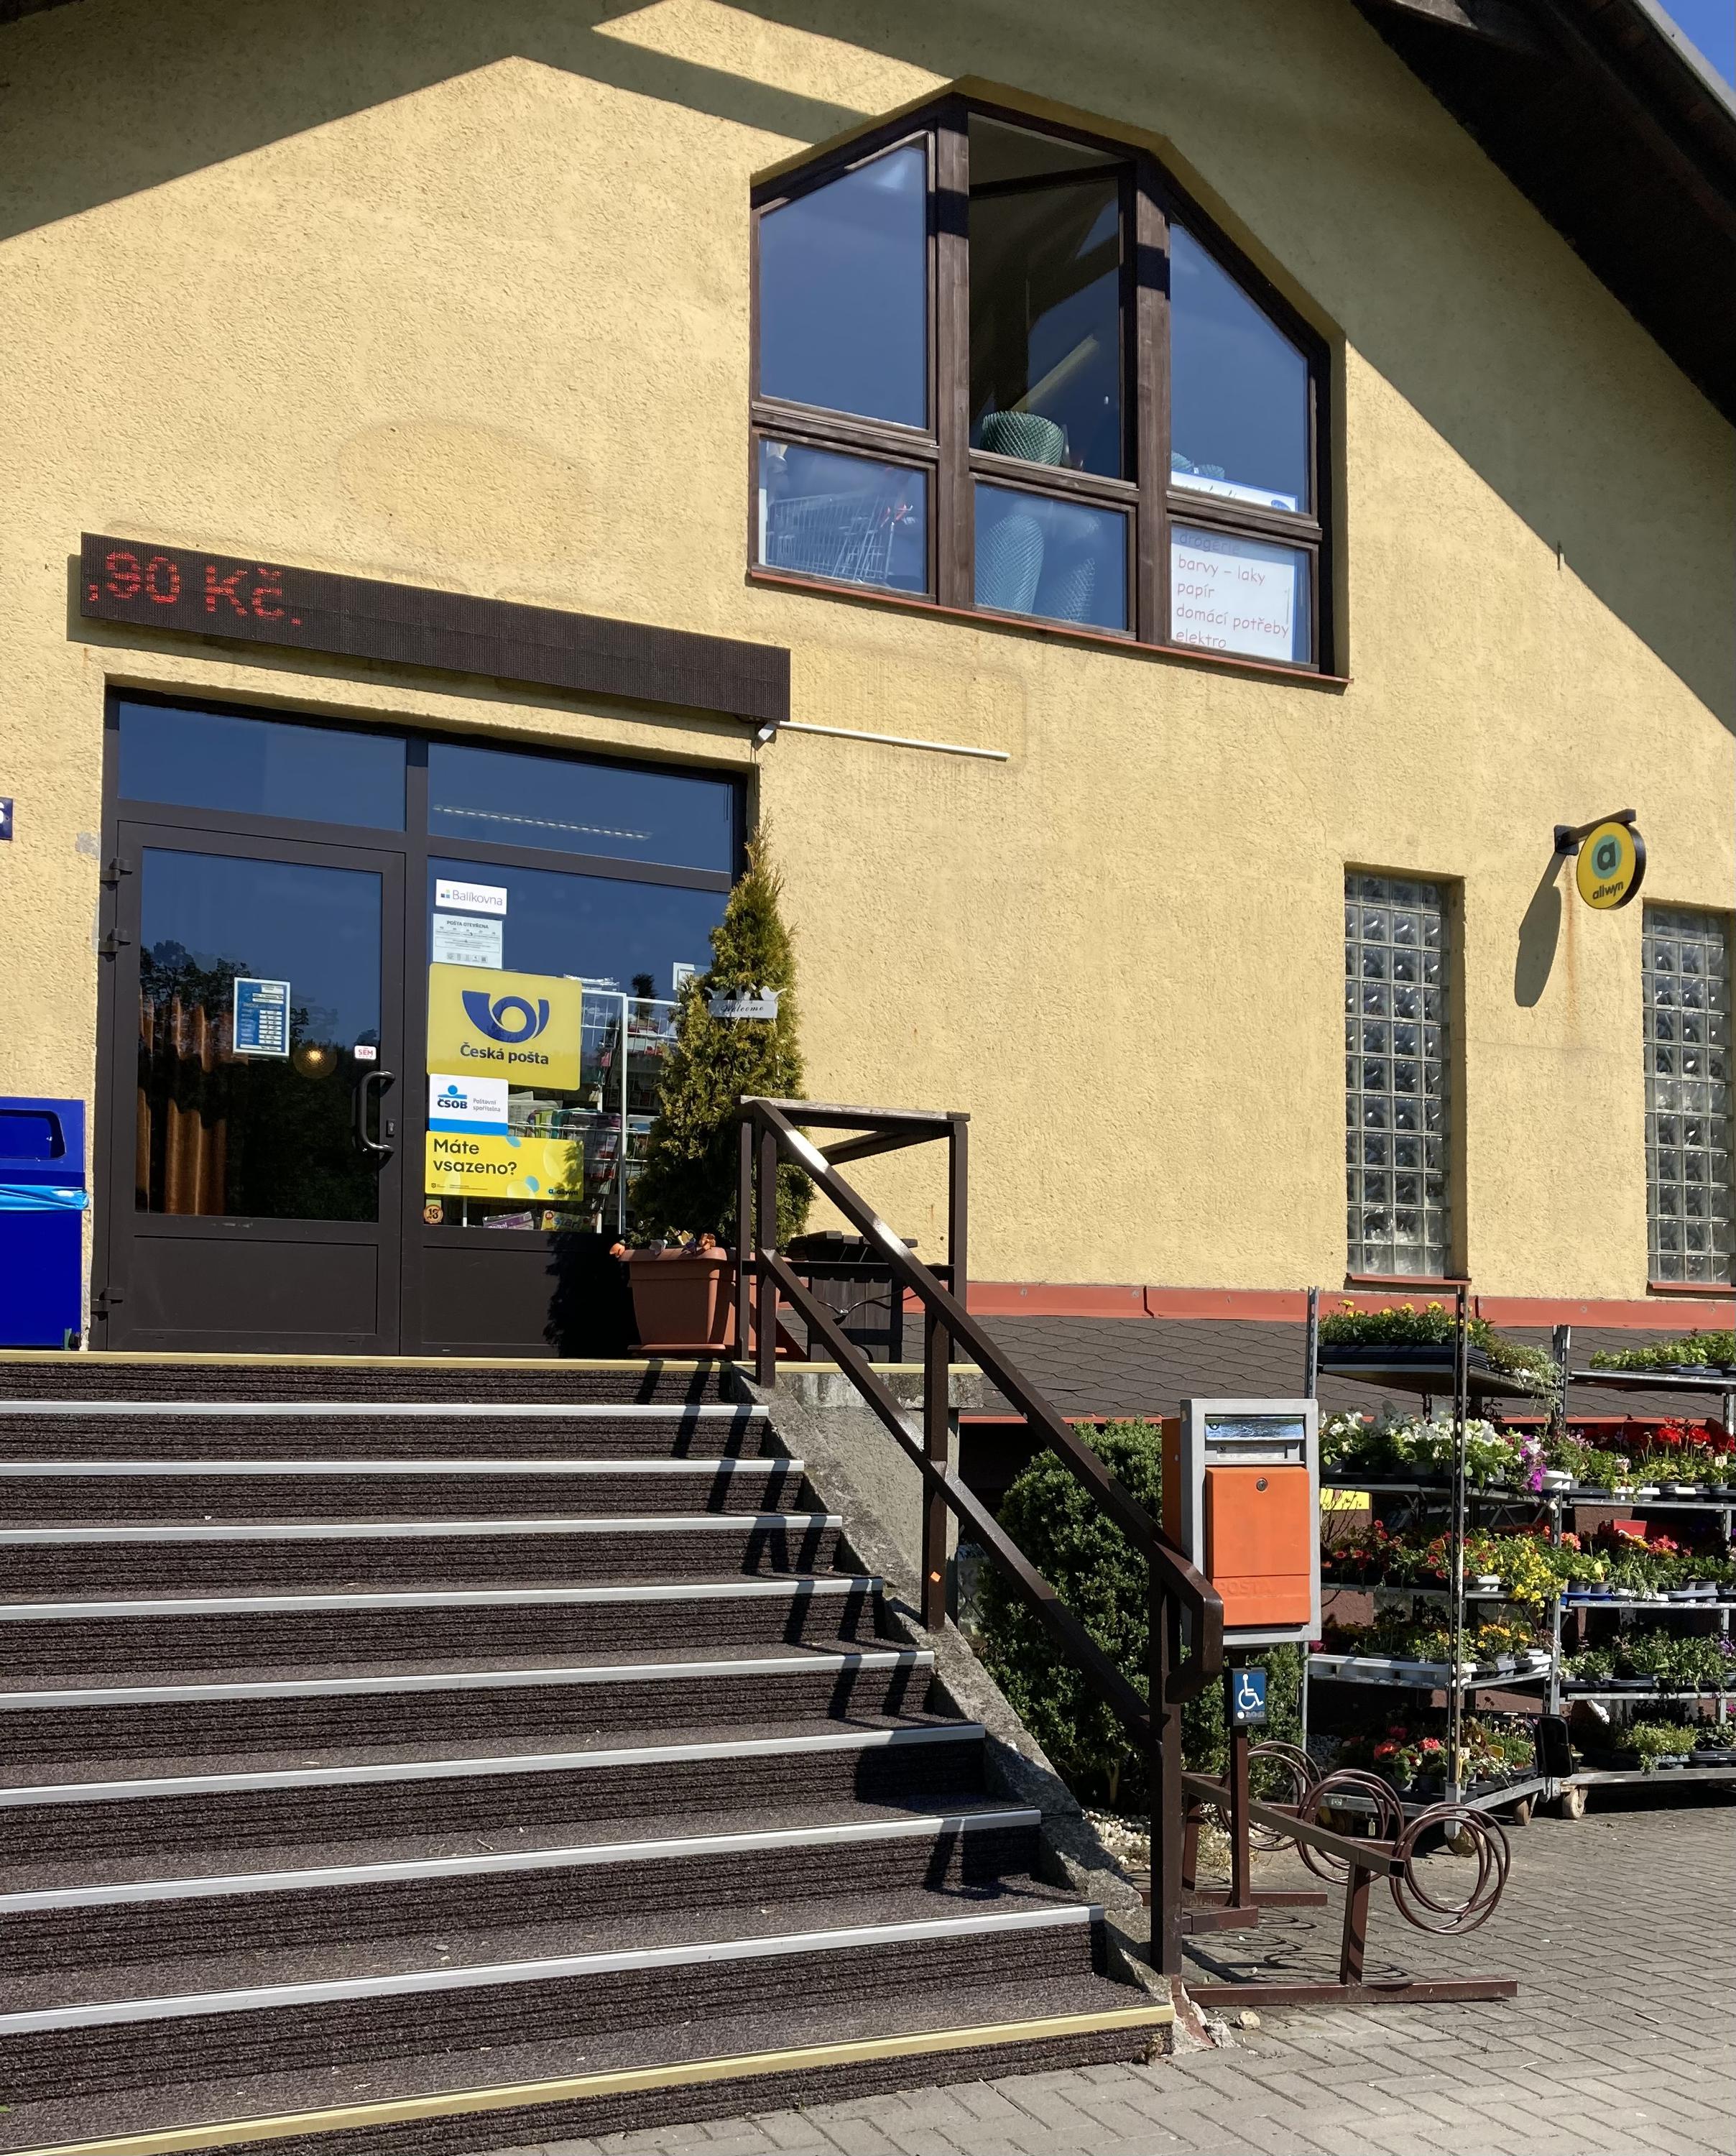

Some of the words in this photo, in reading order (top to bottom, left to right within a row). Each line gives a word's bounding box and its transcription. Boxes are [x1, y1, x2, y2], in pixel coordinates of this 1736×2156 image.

[1178, 553, 1218, 577] barvy
[1237, 566, 1265, 586] laky
[1177, 582, 1215, 599] papír
[1176, 604, 1229, 625] domácí
[1233, 617, 1289, 638] potřeby
[1176, 629, 1227, 648] elektro
[453, 890, 503, 906] Balíkovna
[1592, 881, 1624, 900] allwyn
[720, 1004, 764, 1013] Welcome
[460, 1041, 504, 1060] Česká
[508, 1051, 549, 1065] pošta
[437, 1098, 468, 1109] ČSOB
[433, 1138, 479, 1155] Máte
[433, 1160, 517, 1175] vsazeno?
